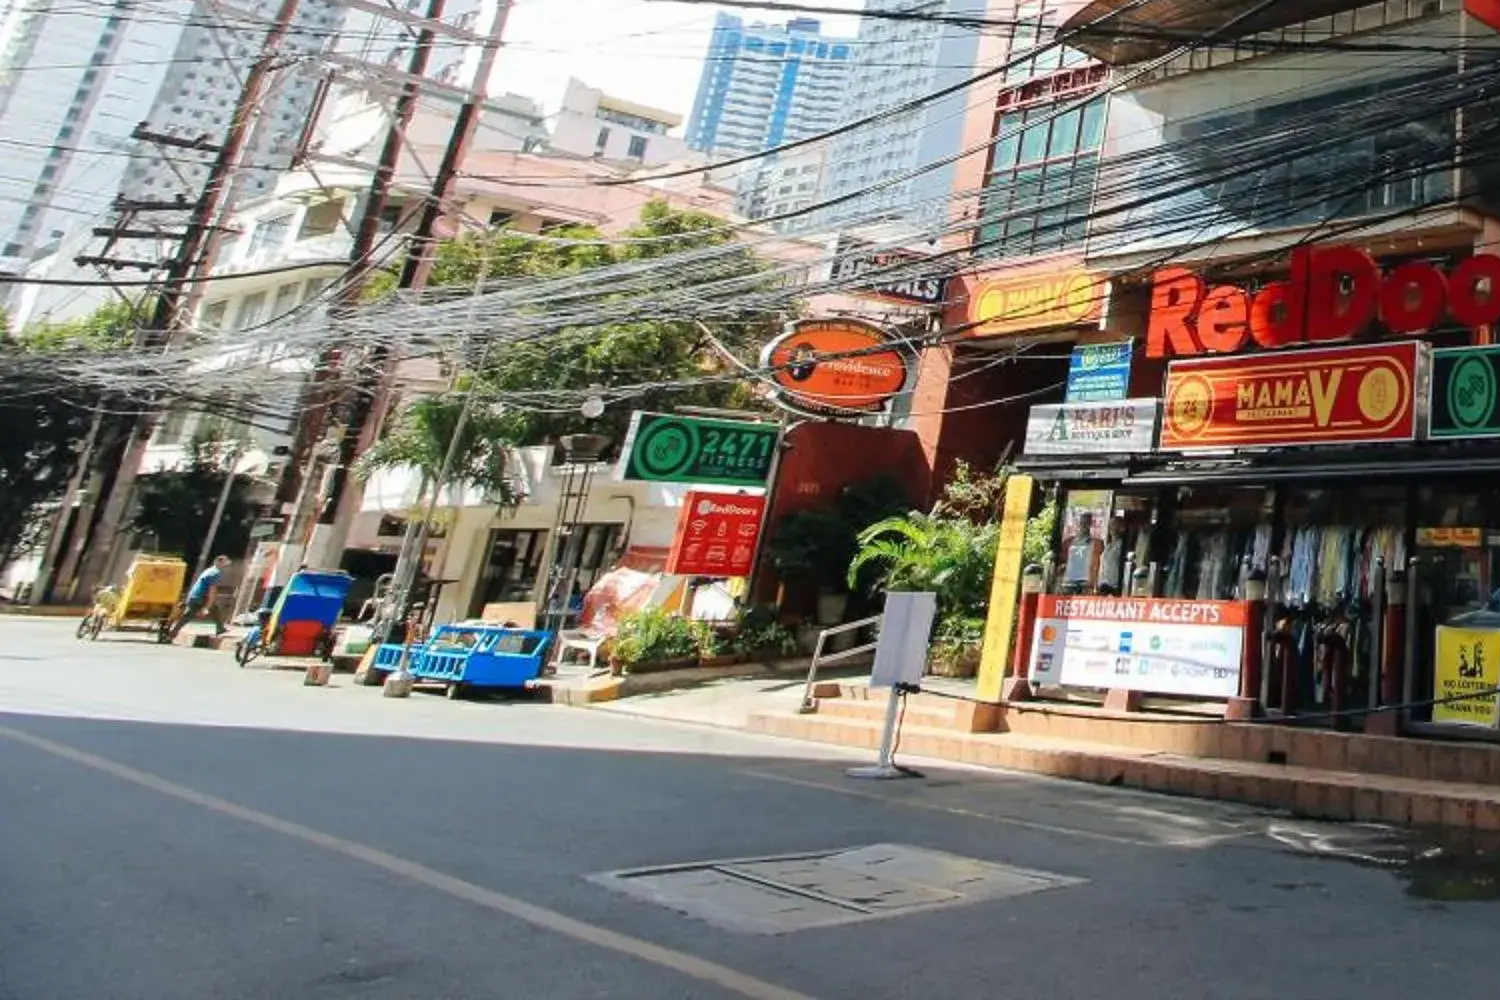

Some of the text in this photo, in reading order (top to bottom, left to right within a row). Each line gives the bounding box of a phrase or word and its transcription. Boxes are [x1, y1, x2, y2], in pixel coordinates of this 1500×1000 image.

[1236, 367, 1344, 427] MAMA V
[703, 430, 772, 457] 2471
[699, 454, 766, 469] FITNESS
[1055, 598, 1220, 623] RESTAURANT ACCEPTS
